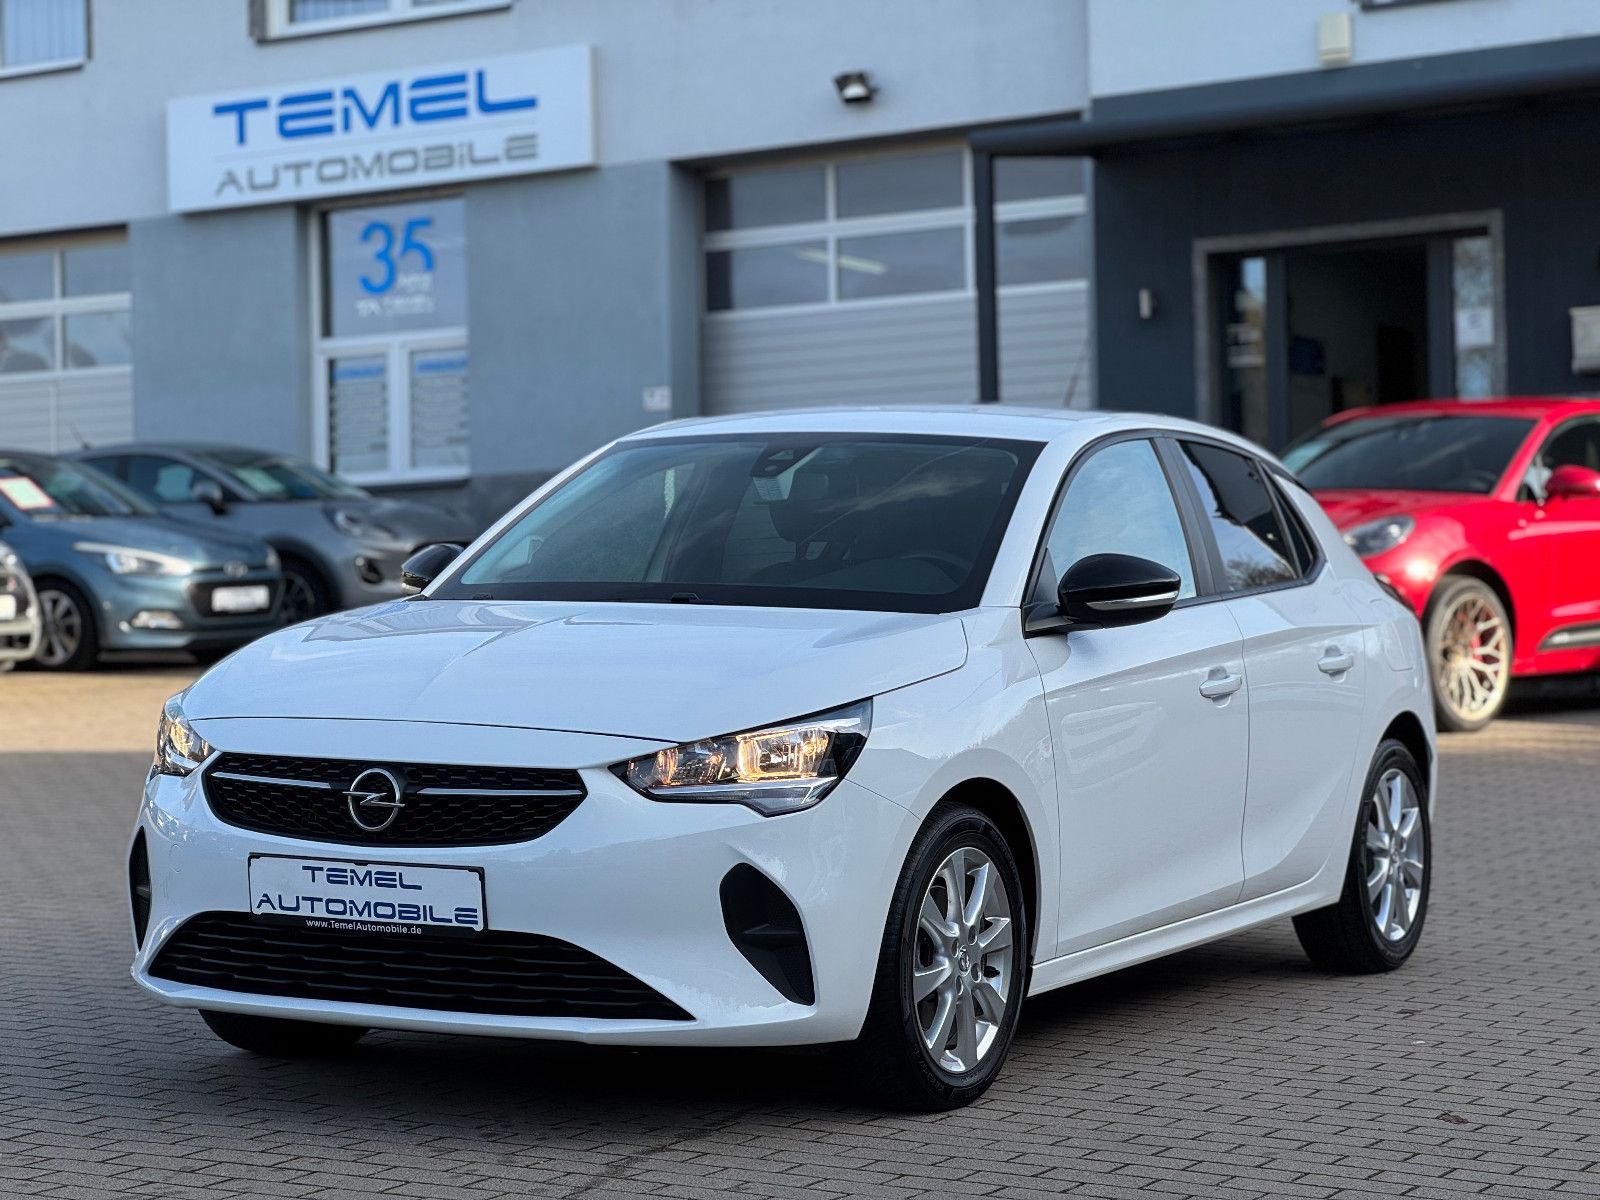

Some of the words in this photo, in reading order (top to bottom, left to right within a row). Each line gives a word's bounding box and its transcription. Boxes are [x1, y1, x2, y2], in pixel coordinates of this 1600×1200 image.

[213, 69, 537, 146] TEMEL
[359, 217, 435, 295] 35
[302, 866, 422, 890] TEMEL
[257, 893, 479, 925] AUTOMOBILE
[305, 919, 422, 935] www.TemelAutomobile.de
